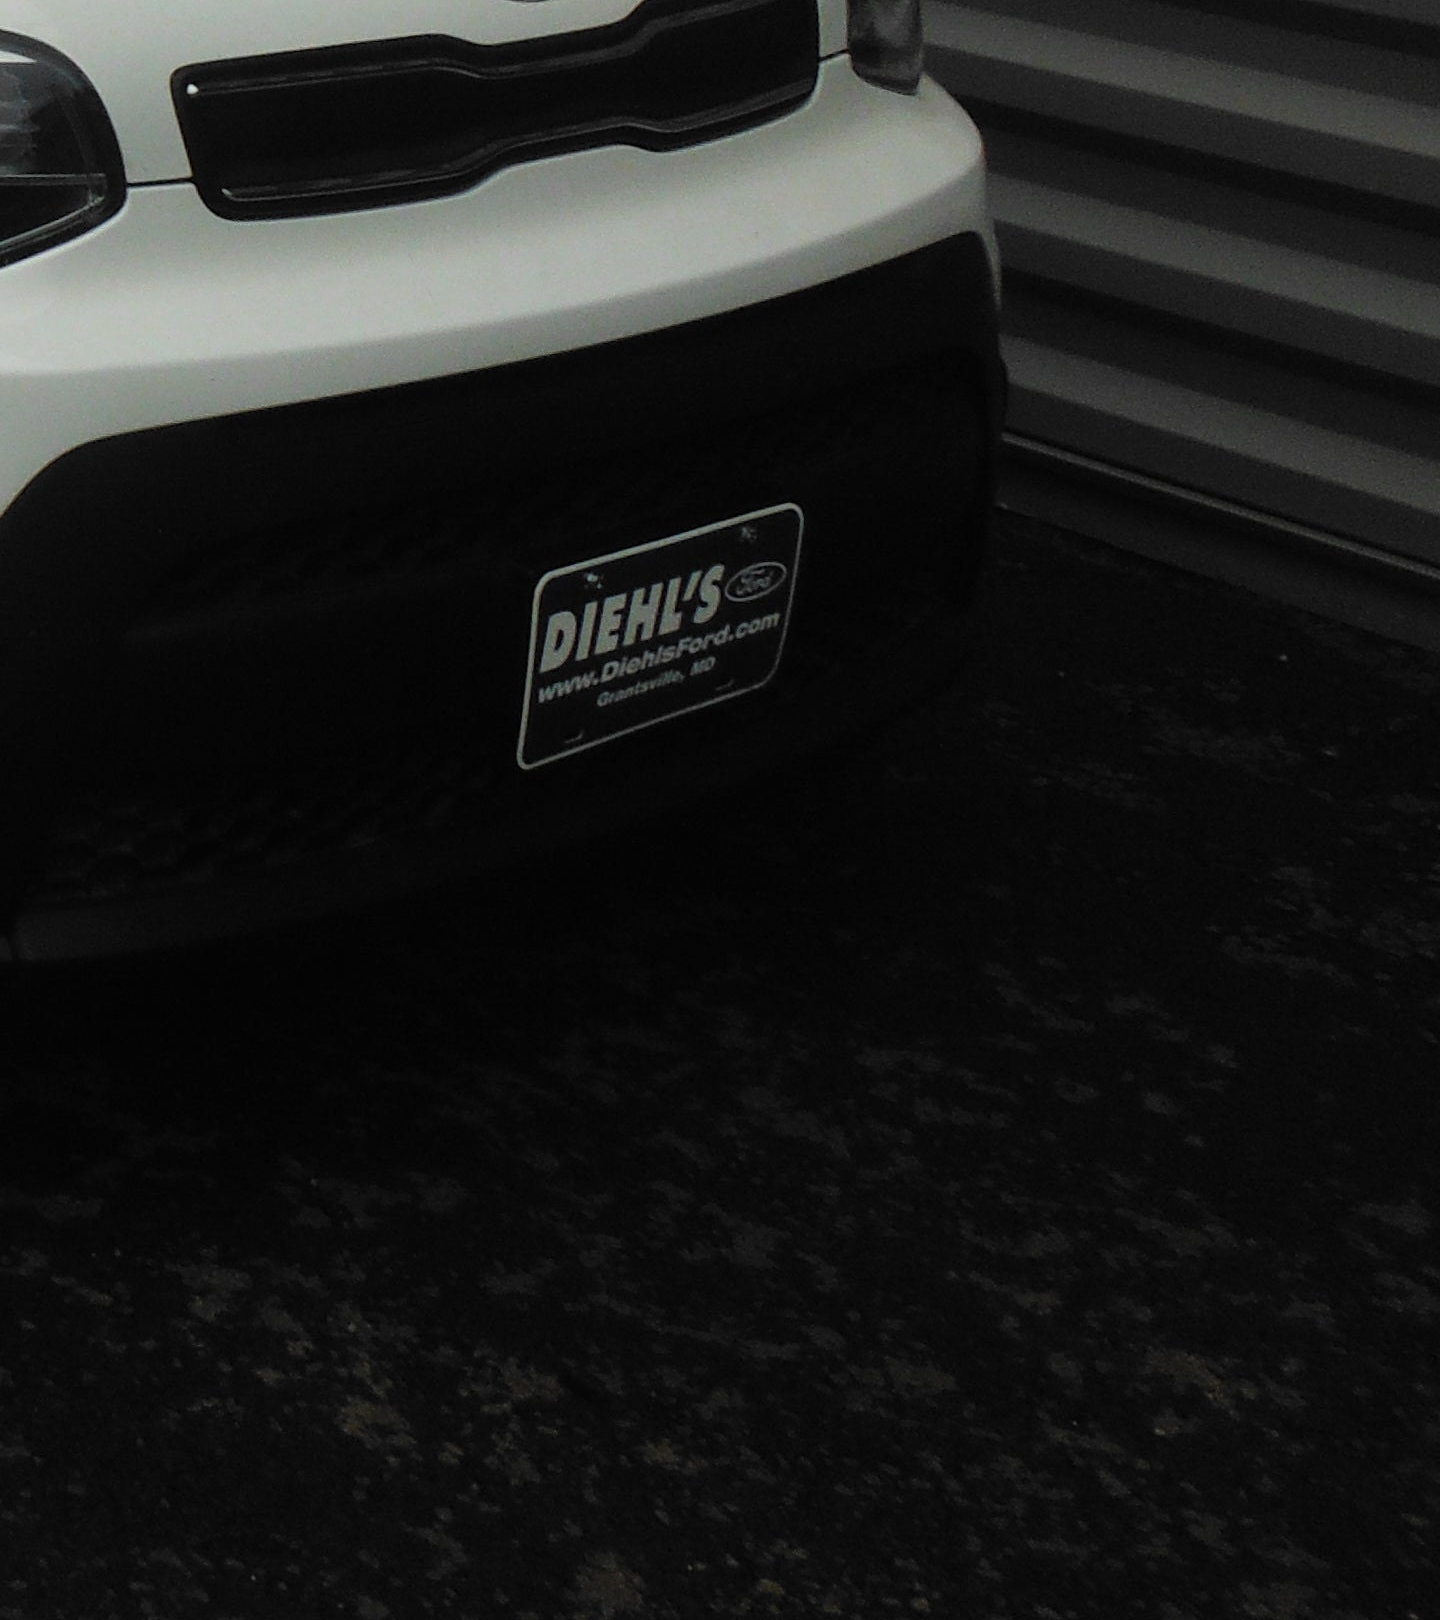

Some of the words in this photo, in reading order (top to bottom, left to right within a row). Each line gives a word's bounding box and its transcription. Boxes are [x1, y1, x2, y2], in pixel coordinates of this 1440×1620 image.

[537, 611, 782, 704] www.DiehlsFord.com
[539, 563, 726, 674] DIEHL'S
[689, 655, 717, 677] MD
